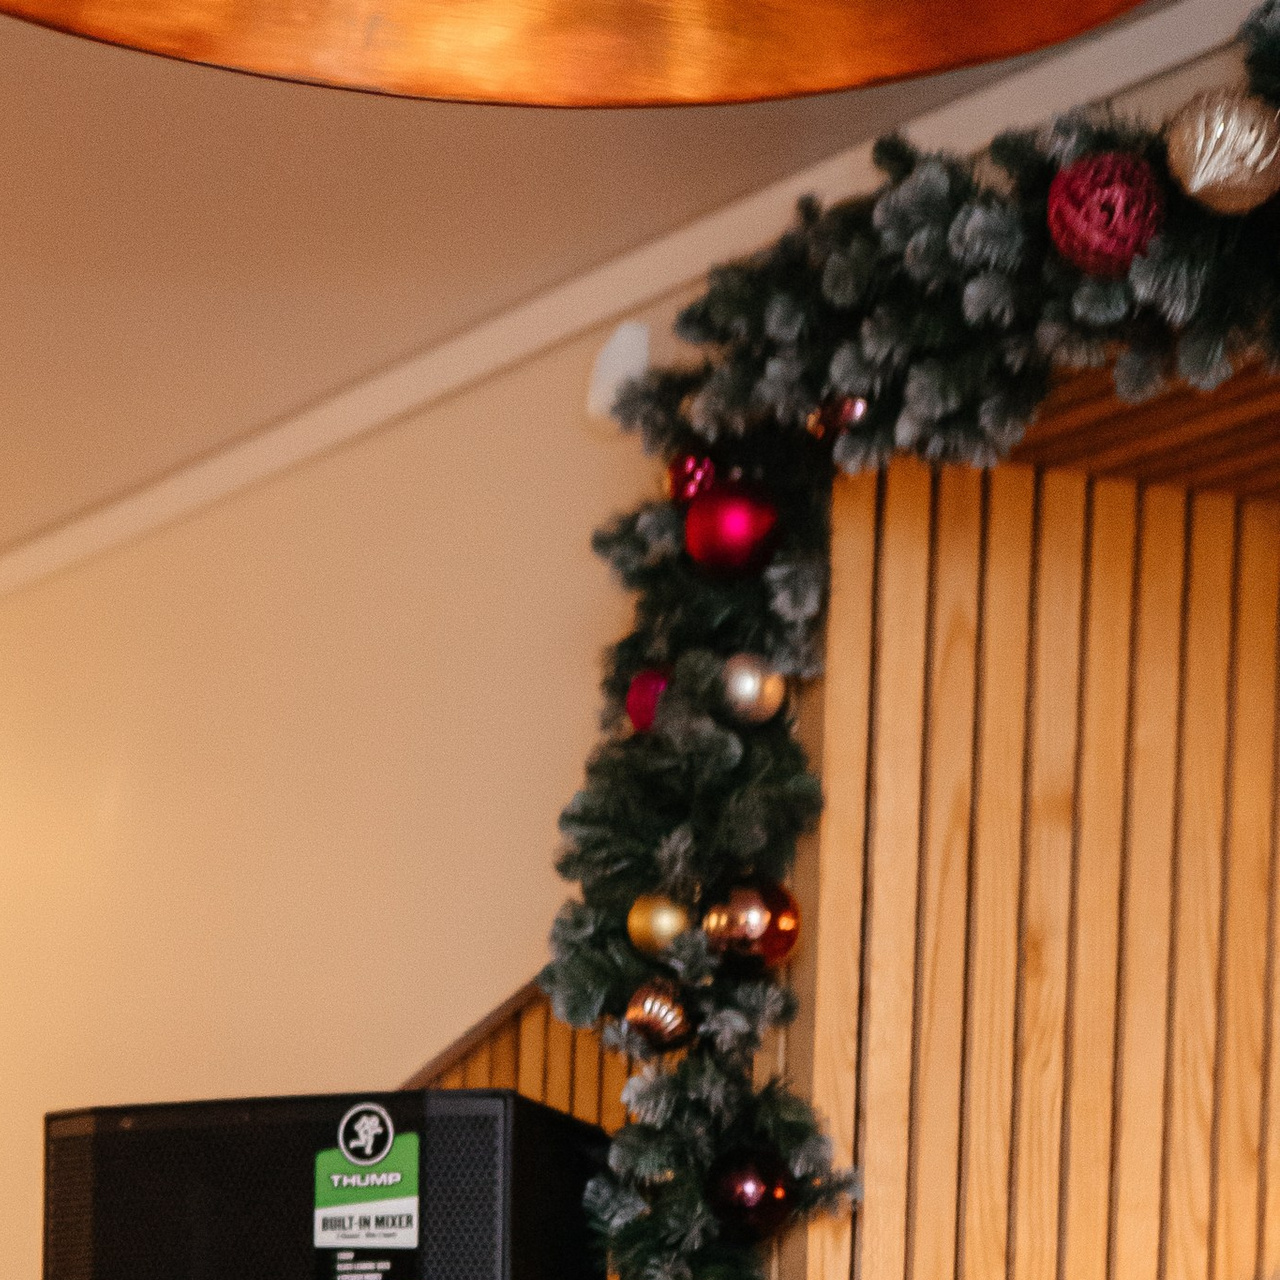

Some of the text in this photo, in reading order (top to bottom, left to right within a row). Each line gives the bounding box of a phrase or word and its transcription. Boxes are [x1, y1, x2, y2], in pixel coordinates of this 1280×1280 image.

[331, 1172, 401, 1187] THUMP
[322, 1214, 413, 1231] BUILT-IN MIXER
